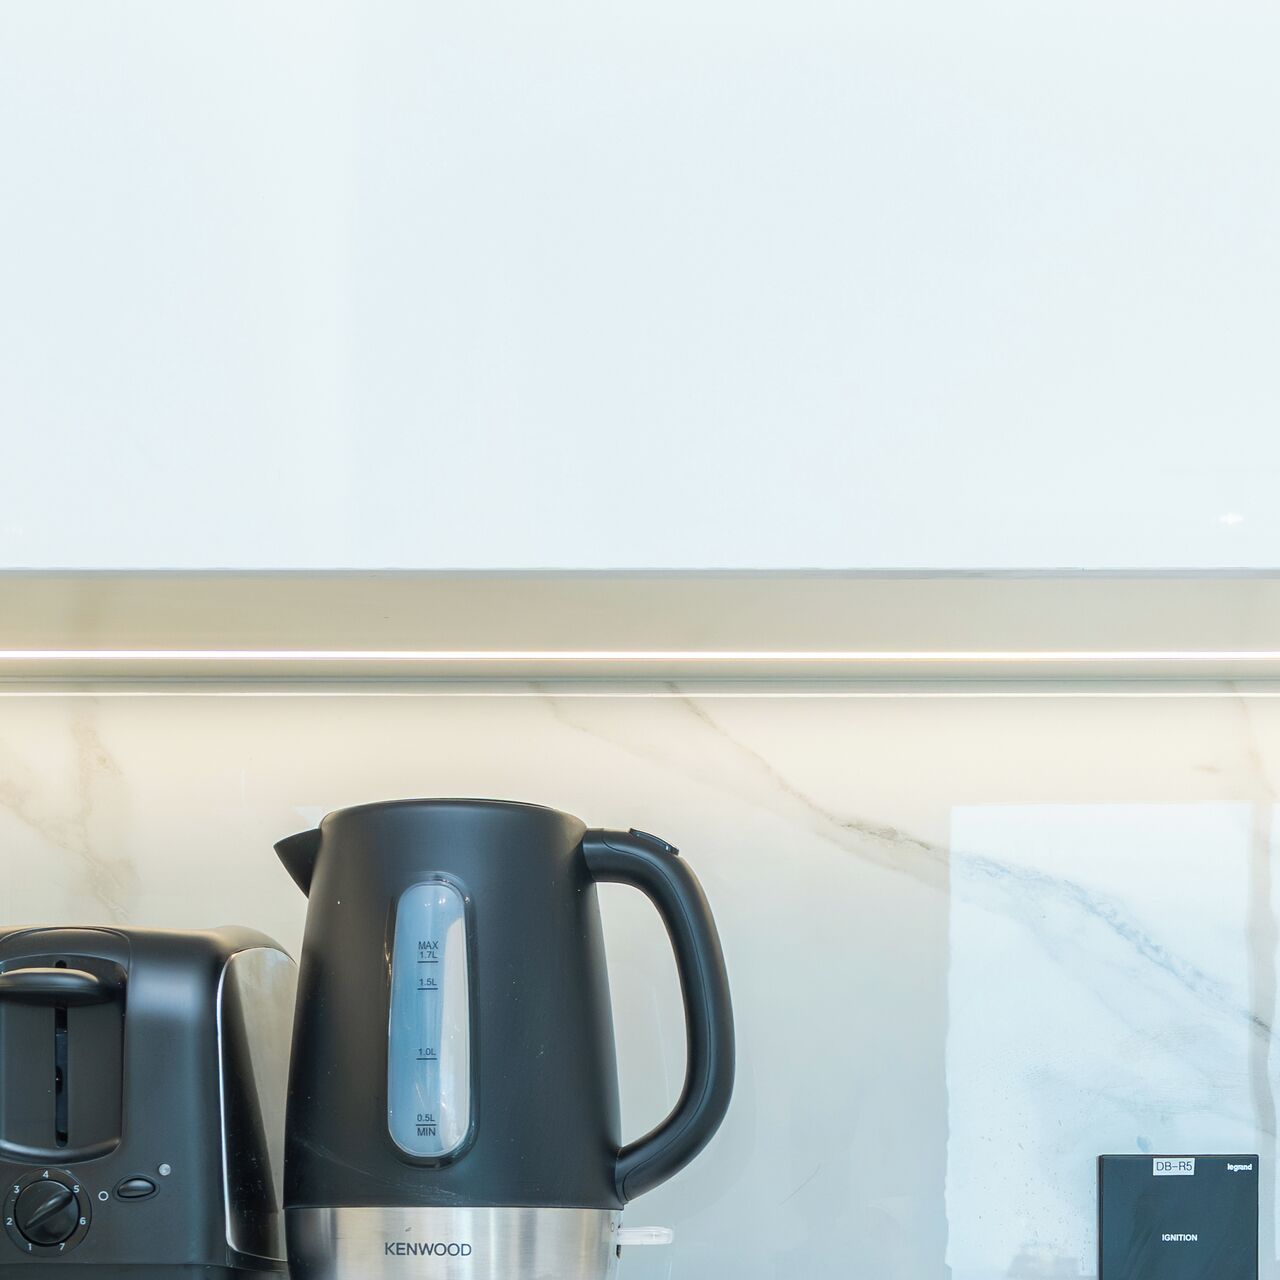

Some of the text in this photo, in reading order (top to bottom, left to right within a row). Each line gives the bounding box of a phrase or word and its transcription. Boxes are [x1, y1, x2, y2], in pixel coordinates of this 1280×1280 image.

[418, 940, 439, 950] MAX
[420, 950, 438, 959] 1.7L
[419, 977, 437, 986] 1.5L
[418, 1047, 436, 1056] 1.0L
[416, 1113, 435, 1122] 0.5L
[417, 1127, 436, 1136] MIN
[1156, 1161, 1193, 1171] DB-R5
[1227, 1163, 1252, 1172] legrand
[42, 1170, 49, 1178] 4
[13, 1185, 20, 1194] 3
[73, 1185, 80, 1193] 5
[6, 1217, 13, 1226] 2
[79, 1217, 87, 1225] 6
[1161, 1233, 1198, 1242] IGNITION
[28, 1243, 33, 1251] 1
[59, 1242, 66, 1251] 7
[384, 1242, 472, 1257] KENWOOD
